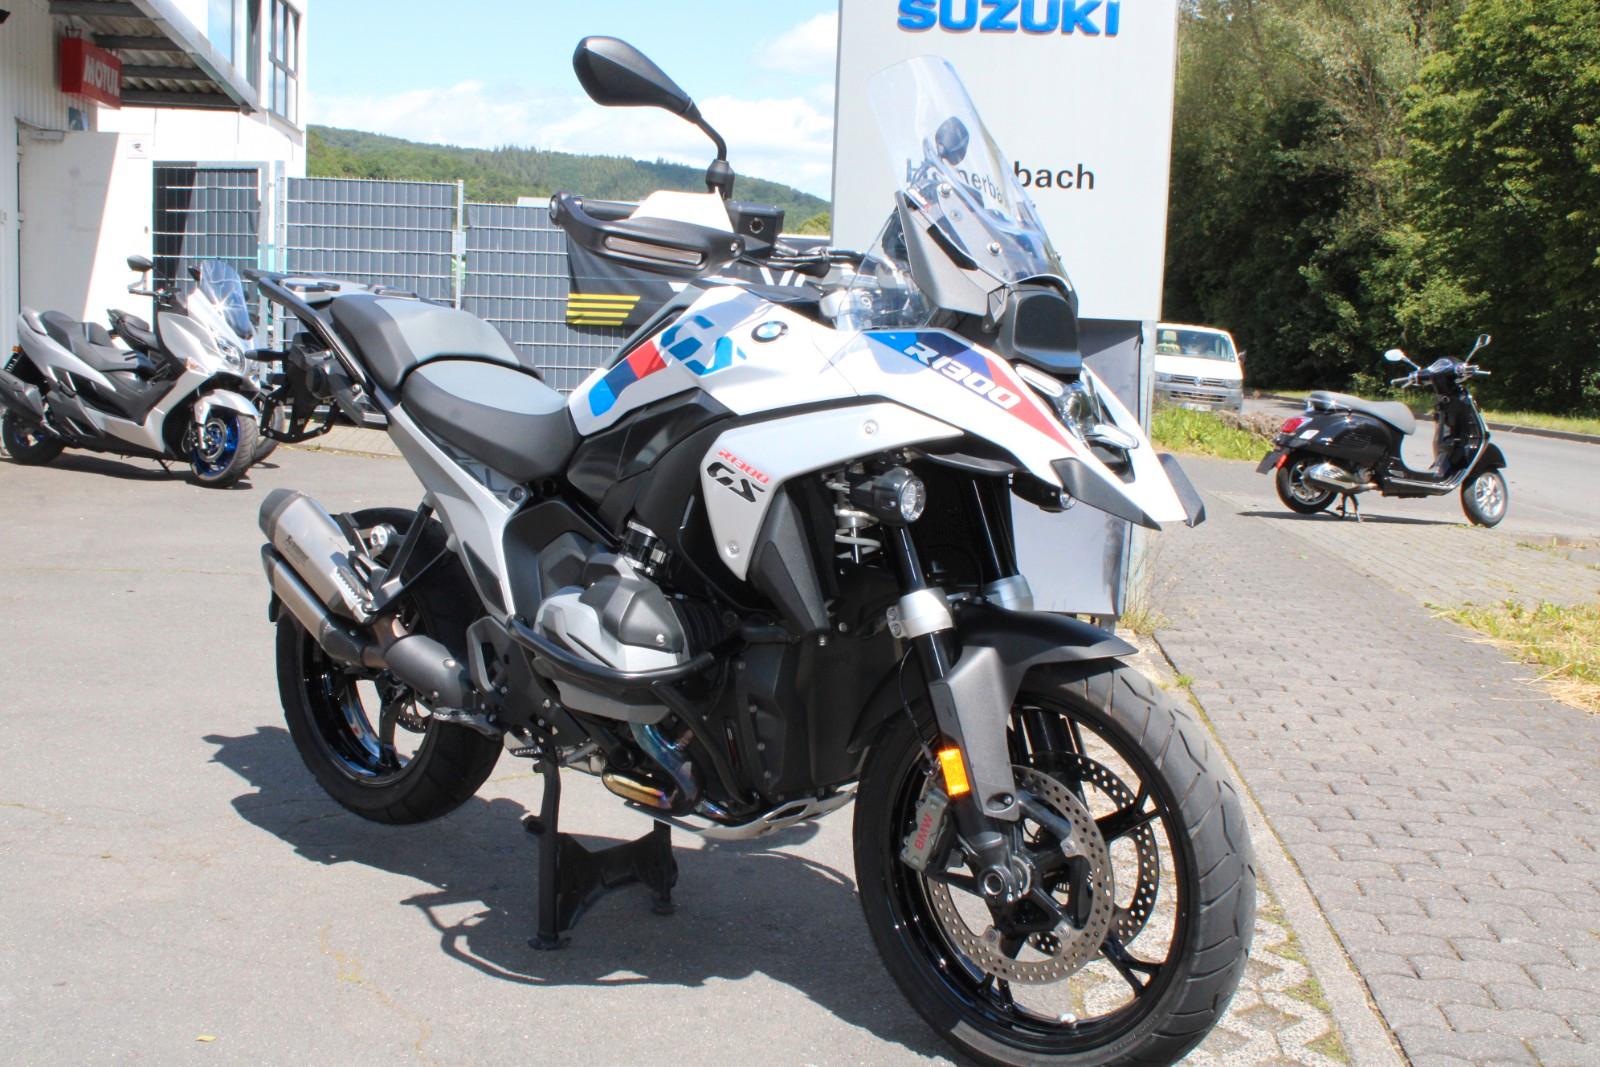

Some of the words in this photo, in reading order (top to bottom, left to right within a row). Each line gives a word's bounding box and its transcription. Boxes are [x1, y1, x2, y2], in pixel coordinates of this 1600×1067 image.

[897, 0, 1120, 37] SUZUKI
[83, 54, 120, 97] MOTUL
[903, 341, 1021, 410] R1300
[706, 462, 766, 503] GS
[914, 812, 933, 850] BMW
